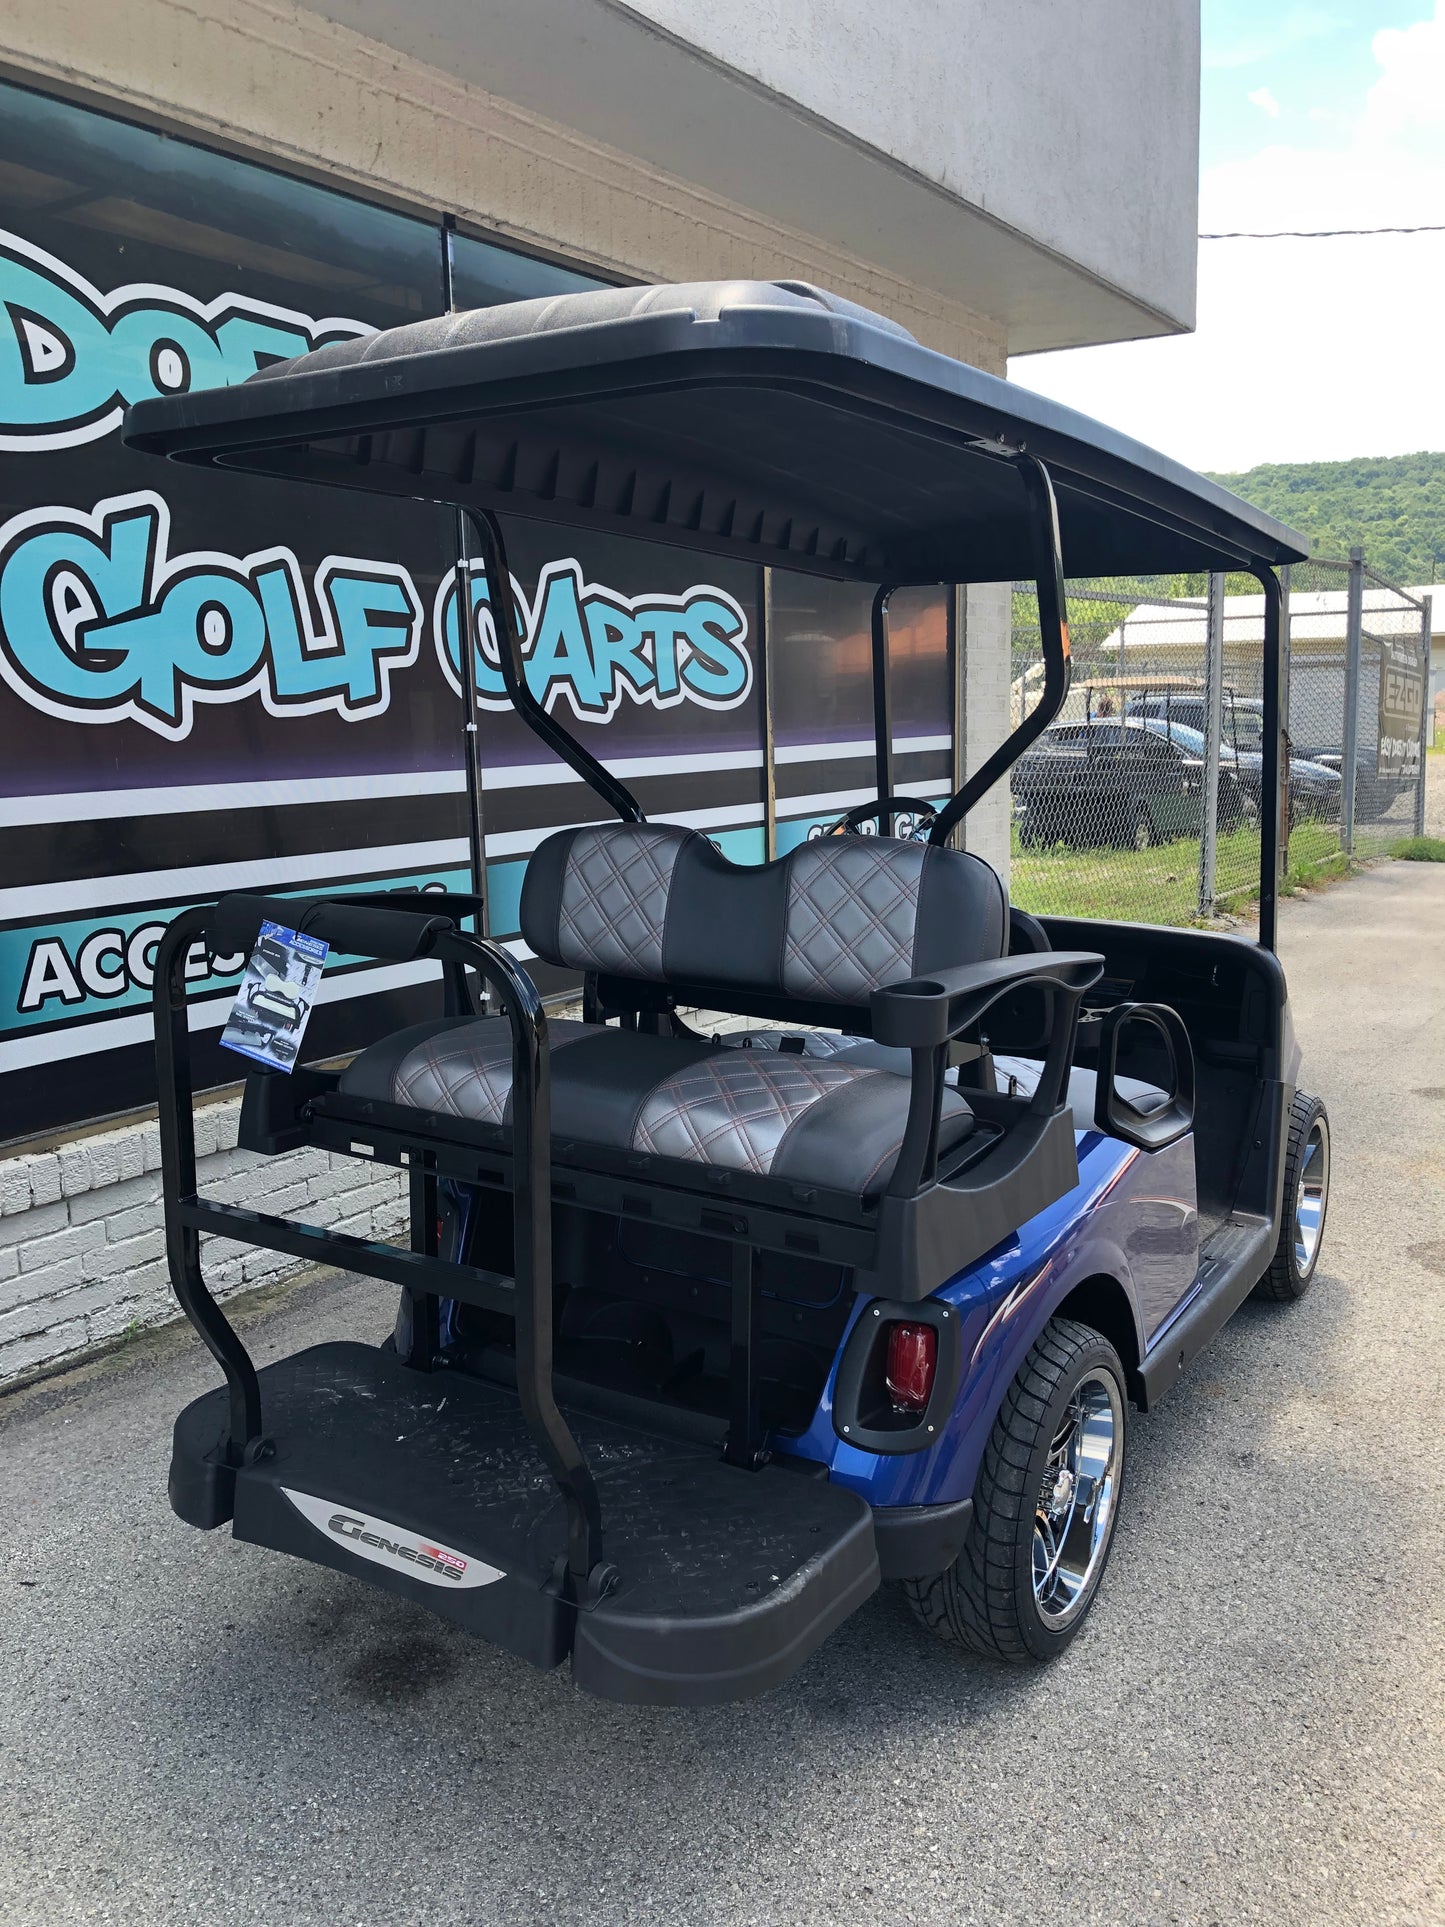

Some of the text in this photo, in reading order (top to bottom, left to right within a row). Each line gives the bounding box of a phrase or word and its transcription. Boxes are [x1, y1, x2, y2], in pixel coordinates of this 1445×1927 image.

[0, 492, 752, 740] GOLF CARTS
[328, 1514, 464, 1581] GENESIS
